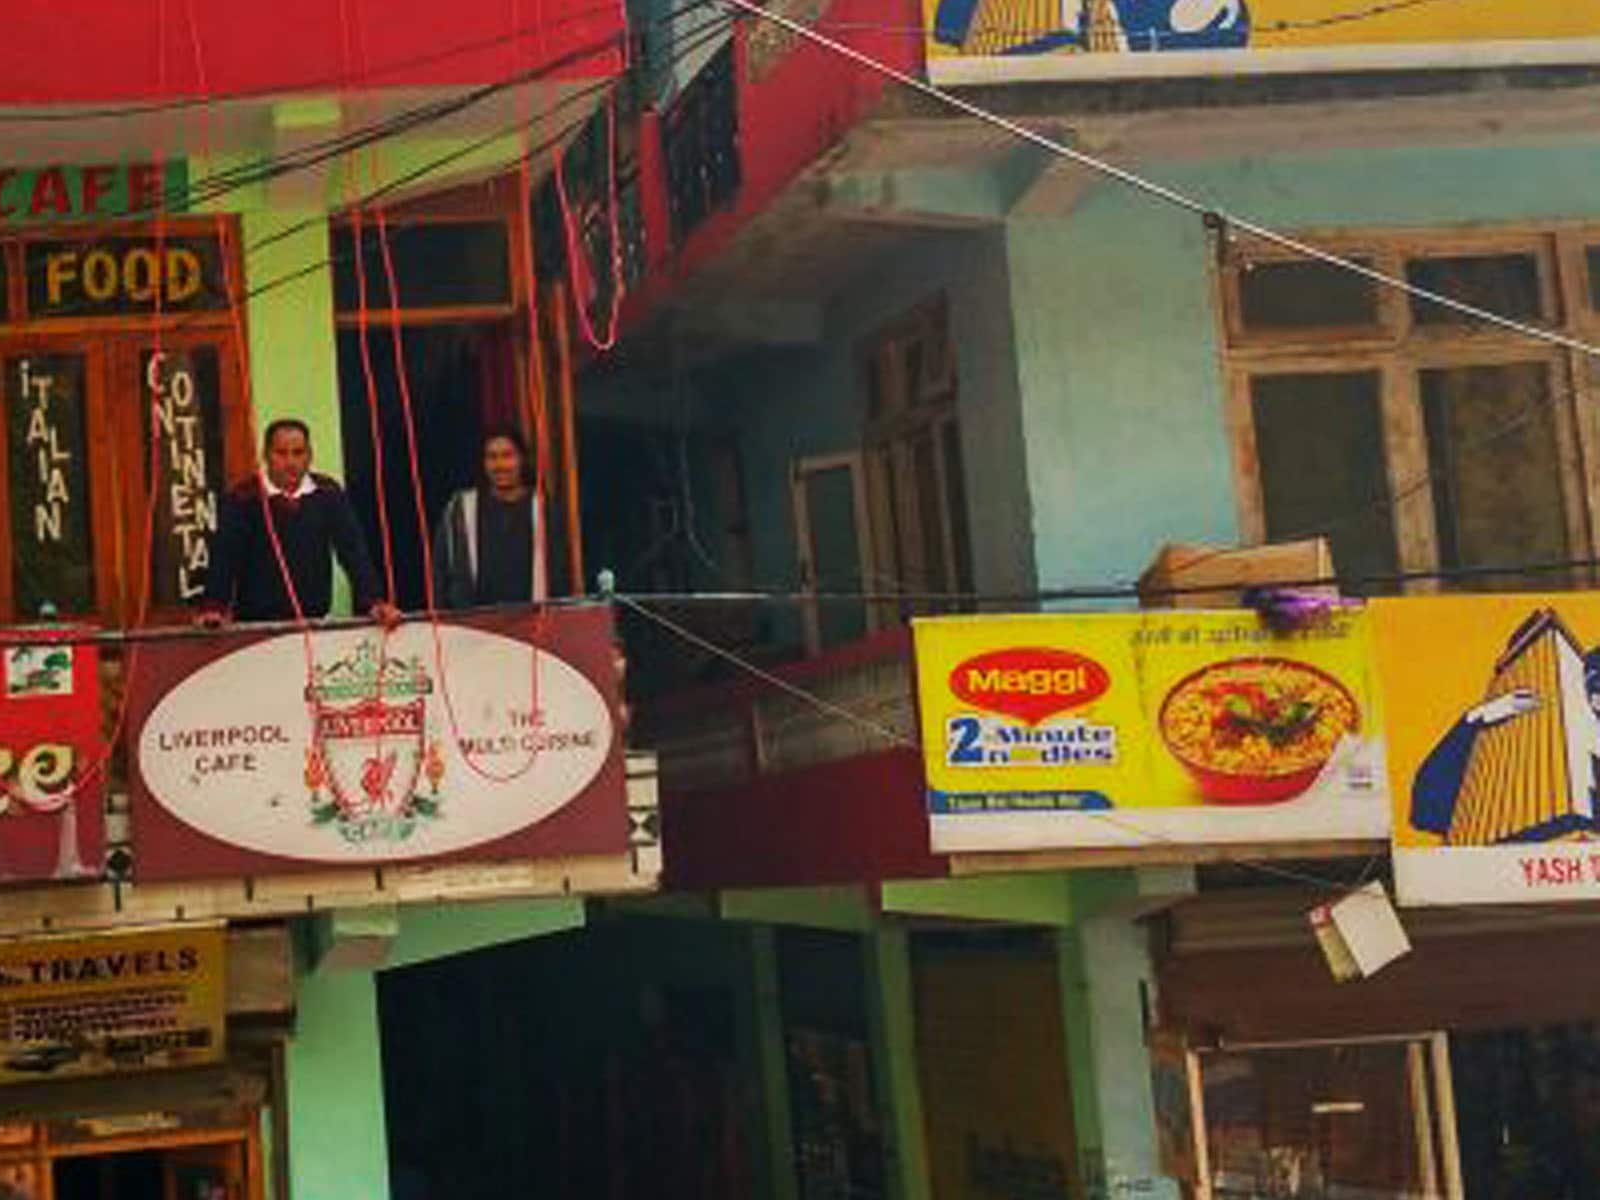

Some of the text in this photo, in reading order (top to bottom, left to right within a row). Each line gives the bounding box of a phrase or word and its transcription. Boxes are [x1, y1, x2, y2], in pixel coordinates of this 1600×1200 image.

[46, 249, 200, 305] FOOD
[967, 667, 1087, 695] Maggi
[159, 725, 290, 752] LIVERPOOL
[949, 717, 984, 763] 2
[195, 753, 258, 776] CAFE
[1518, 856, 1582, 888] YASH
[26, 949, 199, 983] TRAVELS
